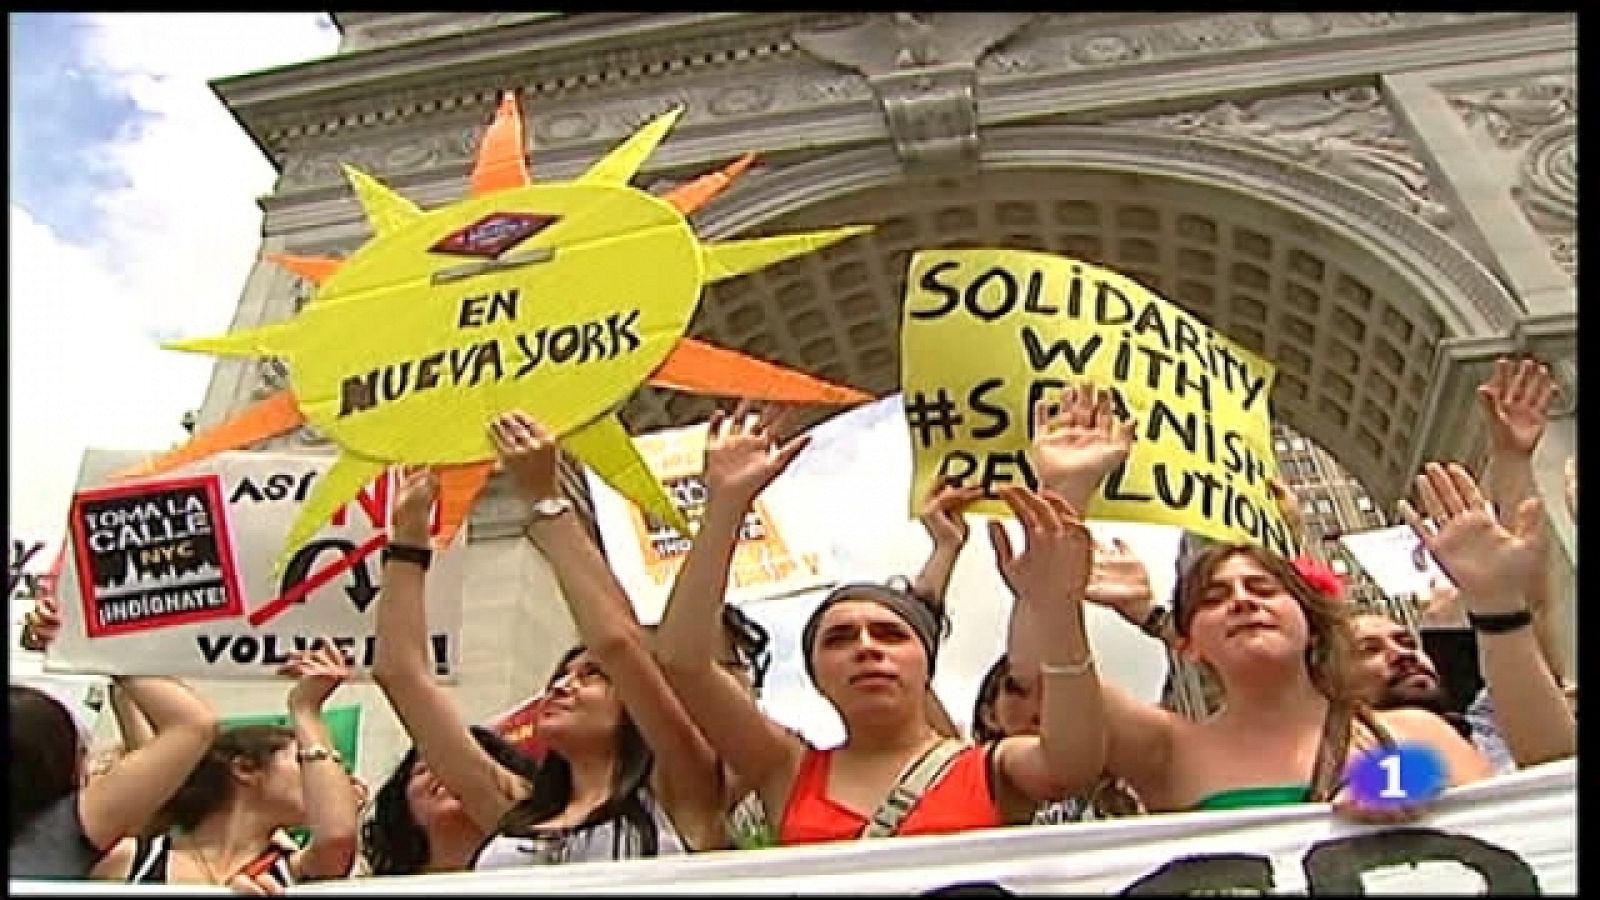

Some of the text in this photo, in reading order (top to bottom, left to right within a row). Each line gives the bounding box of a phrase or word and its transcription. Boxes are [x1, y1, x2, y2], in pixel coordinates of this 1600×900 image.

[459, 289, 519, 328] EN
[338, 309, 641, 417] NUEVA YORK
[230, 471, 317, 503] ASÍ
[85, 495, 204, 530] TOMA LA
[89, 513, 211, 552] CALLE
[140, 540, 195, 566] NYC
